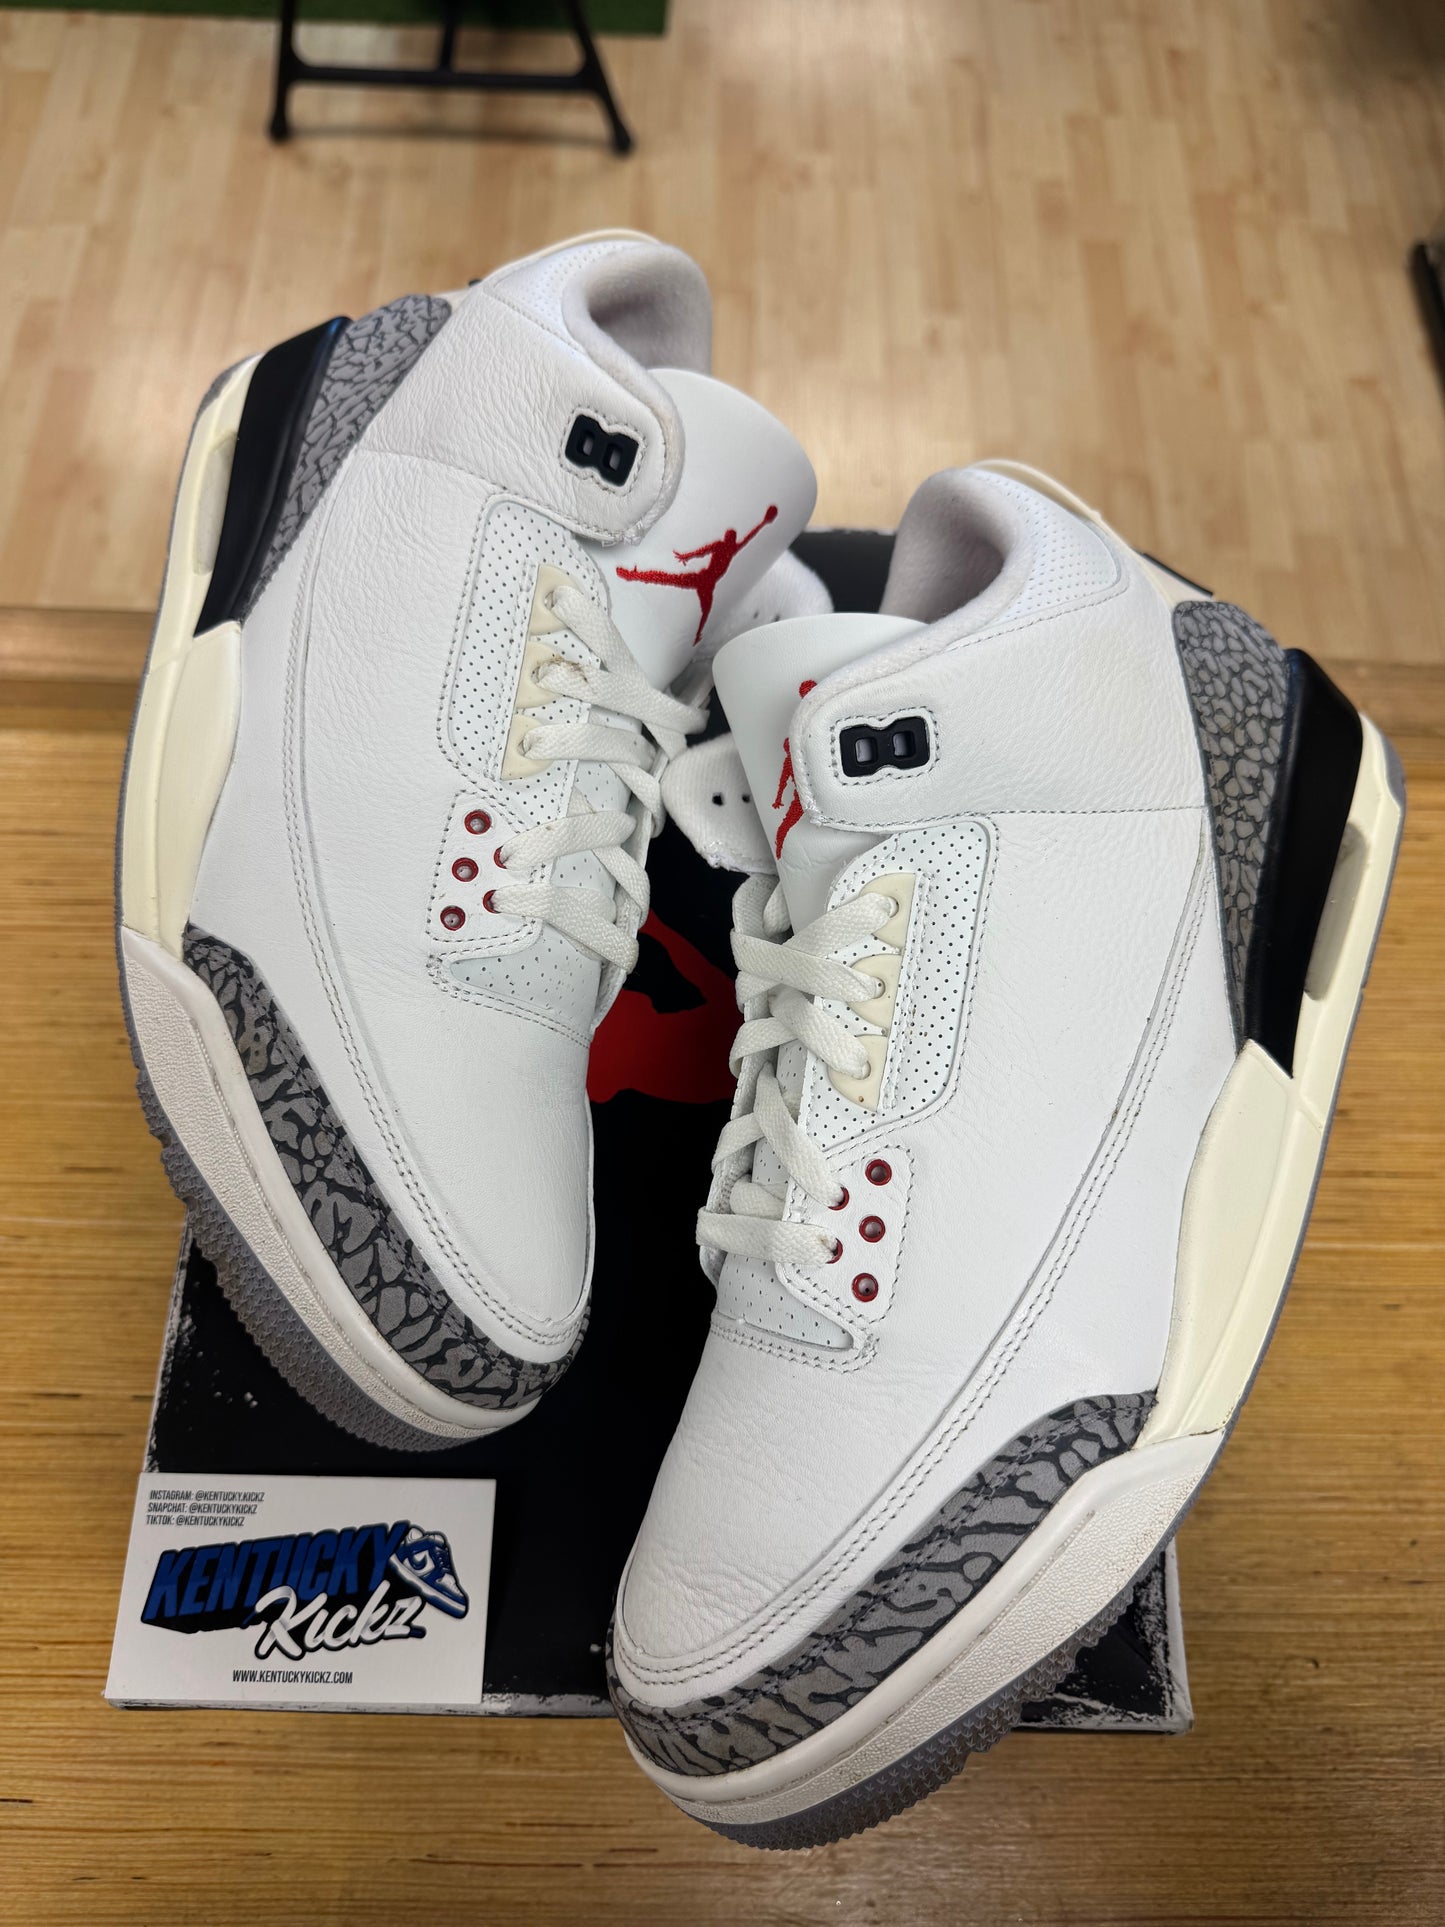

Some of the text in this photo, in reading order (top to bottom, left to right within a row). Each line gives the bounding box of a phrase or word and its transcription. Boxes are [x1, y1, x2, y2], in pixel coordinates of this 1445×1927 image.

[149, 1489, 195, 1501] INSTAGRAM:
[147, 1501, 258, 1515] SNAPCHAT: @KENTUCKYKICKZ
[146, 1514, 245, 1527] TIKTOK: @KENTUCKYKICKZ
[143, 1521, 410, 1626] KENTUCKY
[253, 1578, 424, 1661] Kickz
[232, 1669, 354, 1685] WWW.KENTUCKYKICKZ.COM
